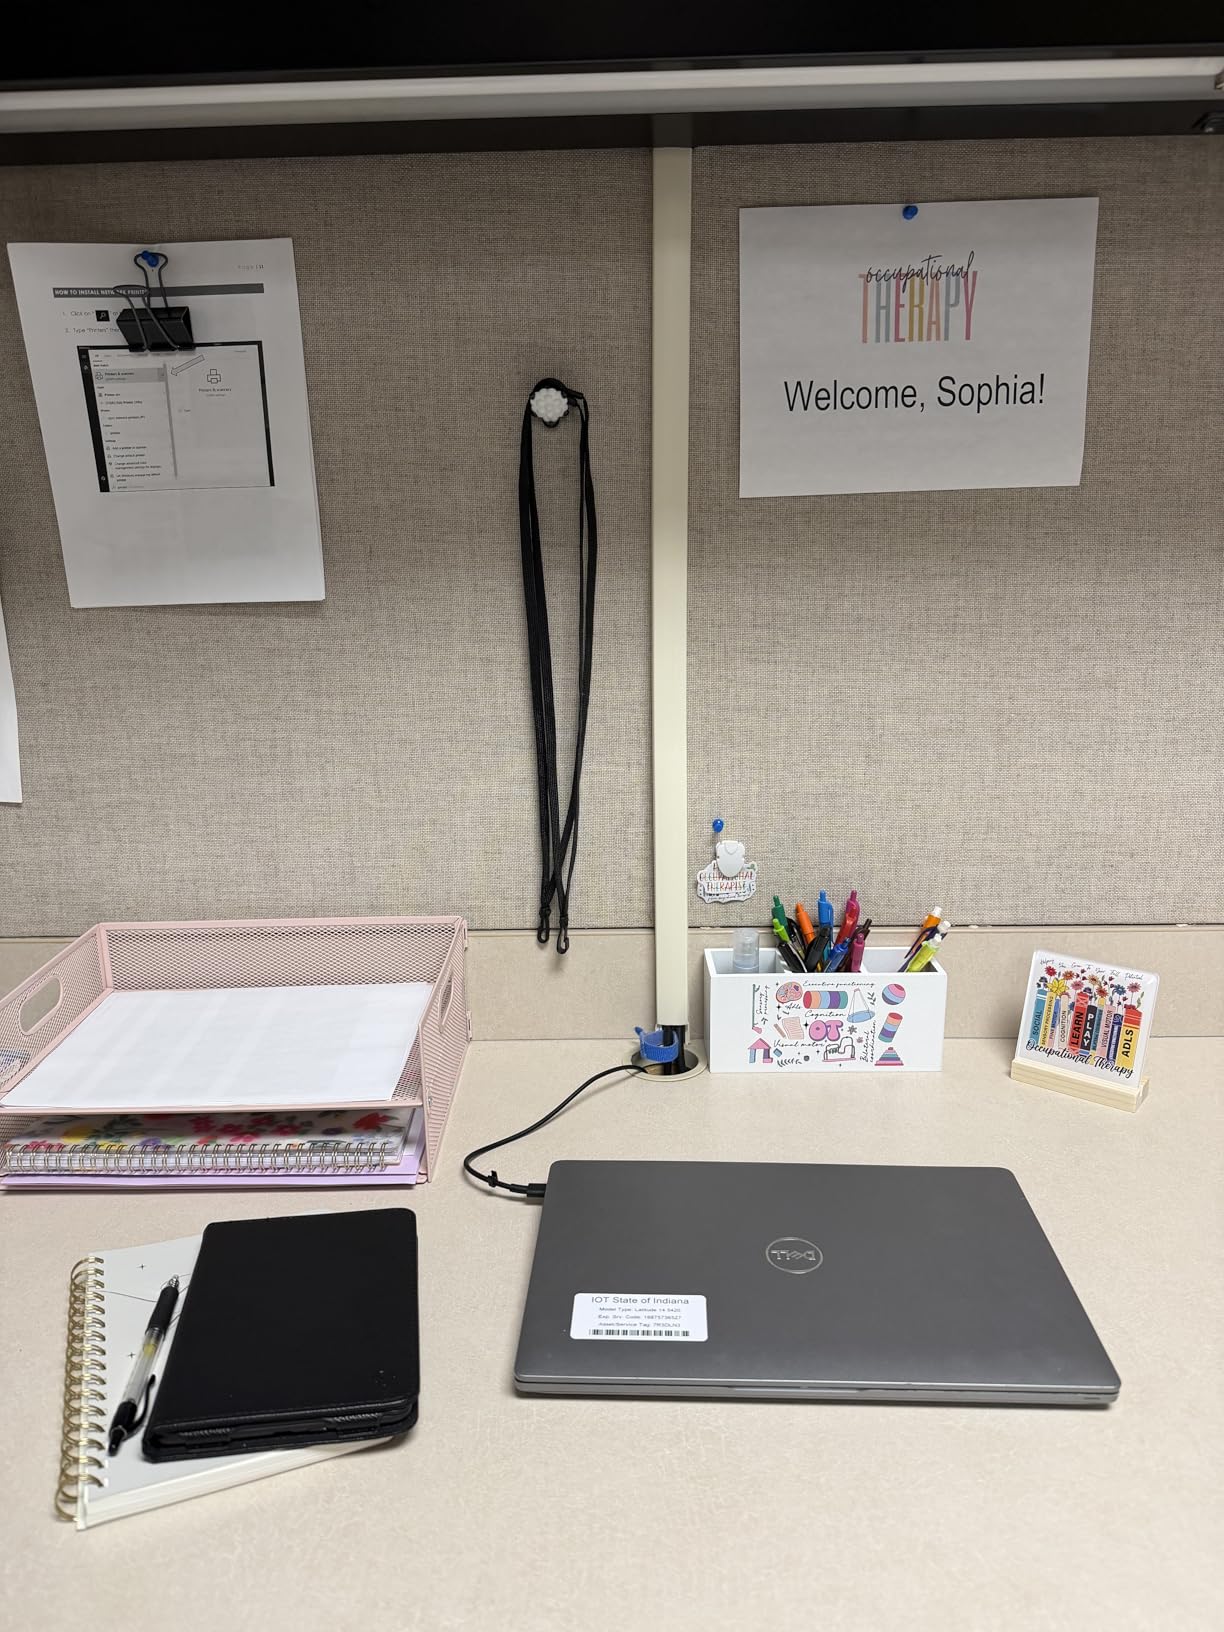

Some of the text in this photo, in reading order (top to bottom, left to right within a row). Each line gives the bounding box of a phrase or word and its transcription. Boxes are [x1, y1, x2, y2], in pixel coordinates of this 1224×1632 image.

[865, 250, 975, 293] occupational
[858, 270, 978, 343] THERAPY
[783, 373, 1045, 413] Welcome, Sophia!
[835, 980, 876, 988] functioning
[804, 1010, 846, 1019] Cognition
[1032, 1010, 1042, 1036] SOCIAL
[1071, 1011, 1084, 1046] LEARN
[1101, 1010, 1113, 1048] VISUAL MOTOR
[773, 1039, 799, 1048] Visual
[808, 1019, 844, 1042] OT
[1083, 1013, 1094, 1047] PLAY
[1121, 1029, 1134, 1058] ADLS
[1026, 1038, 1092, 1064] Occupational
[1093, 1055, 1133, 1078] Therapy
[771, 1249, 816, 1261] DELL
[612, 1296, 638, 1304] State
